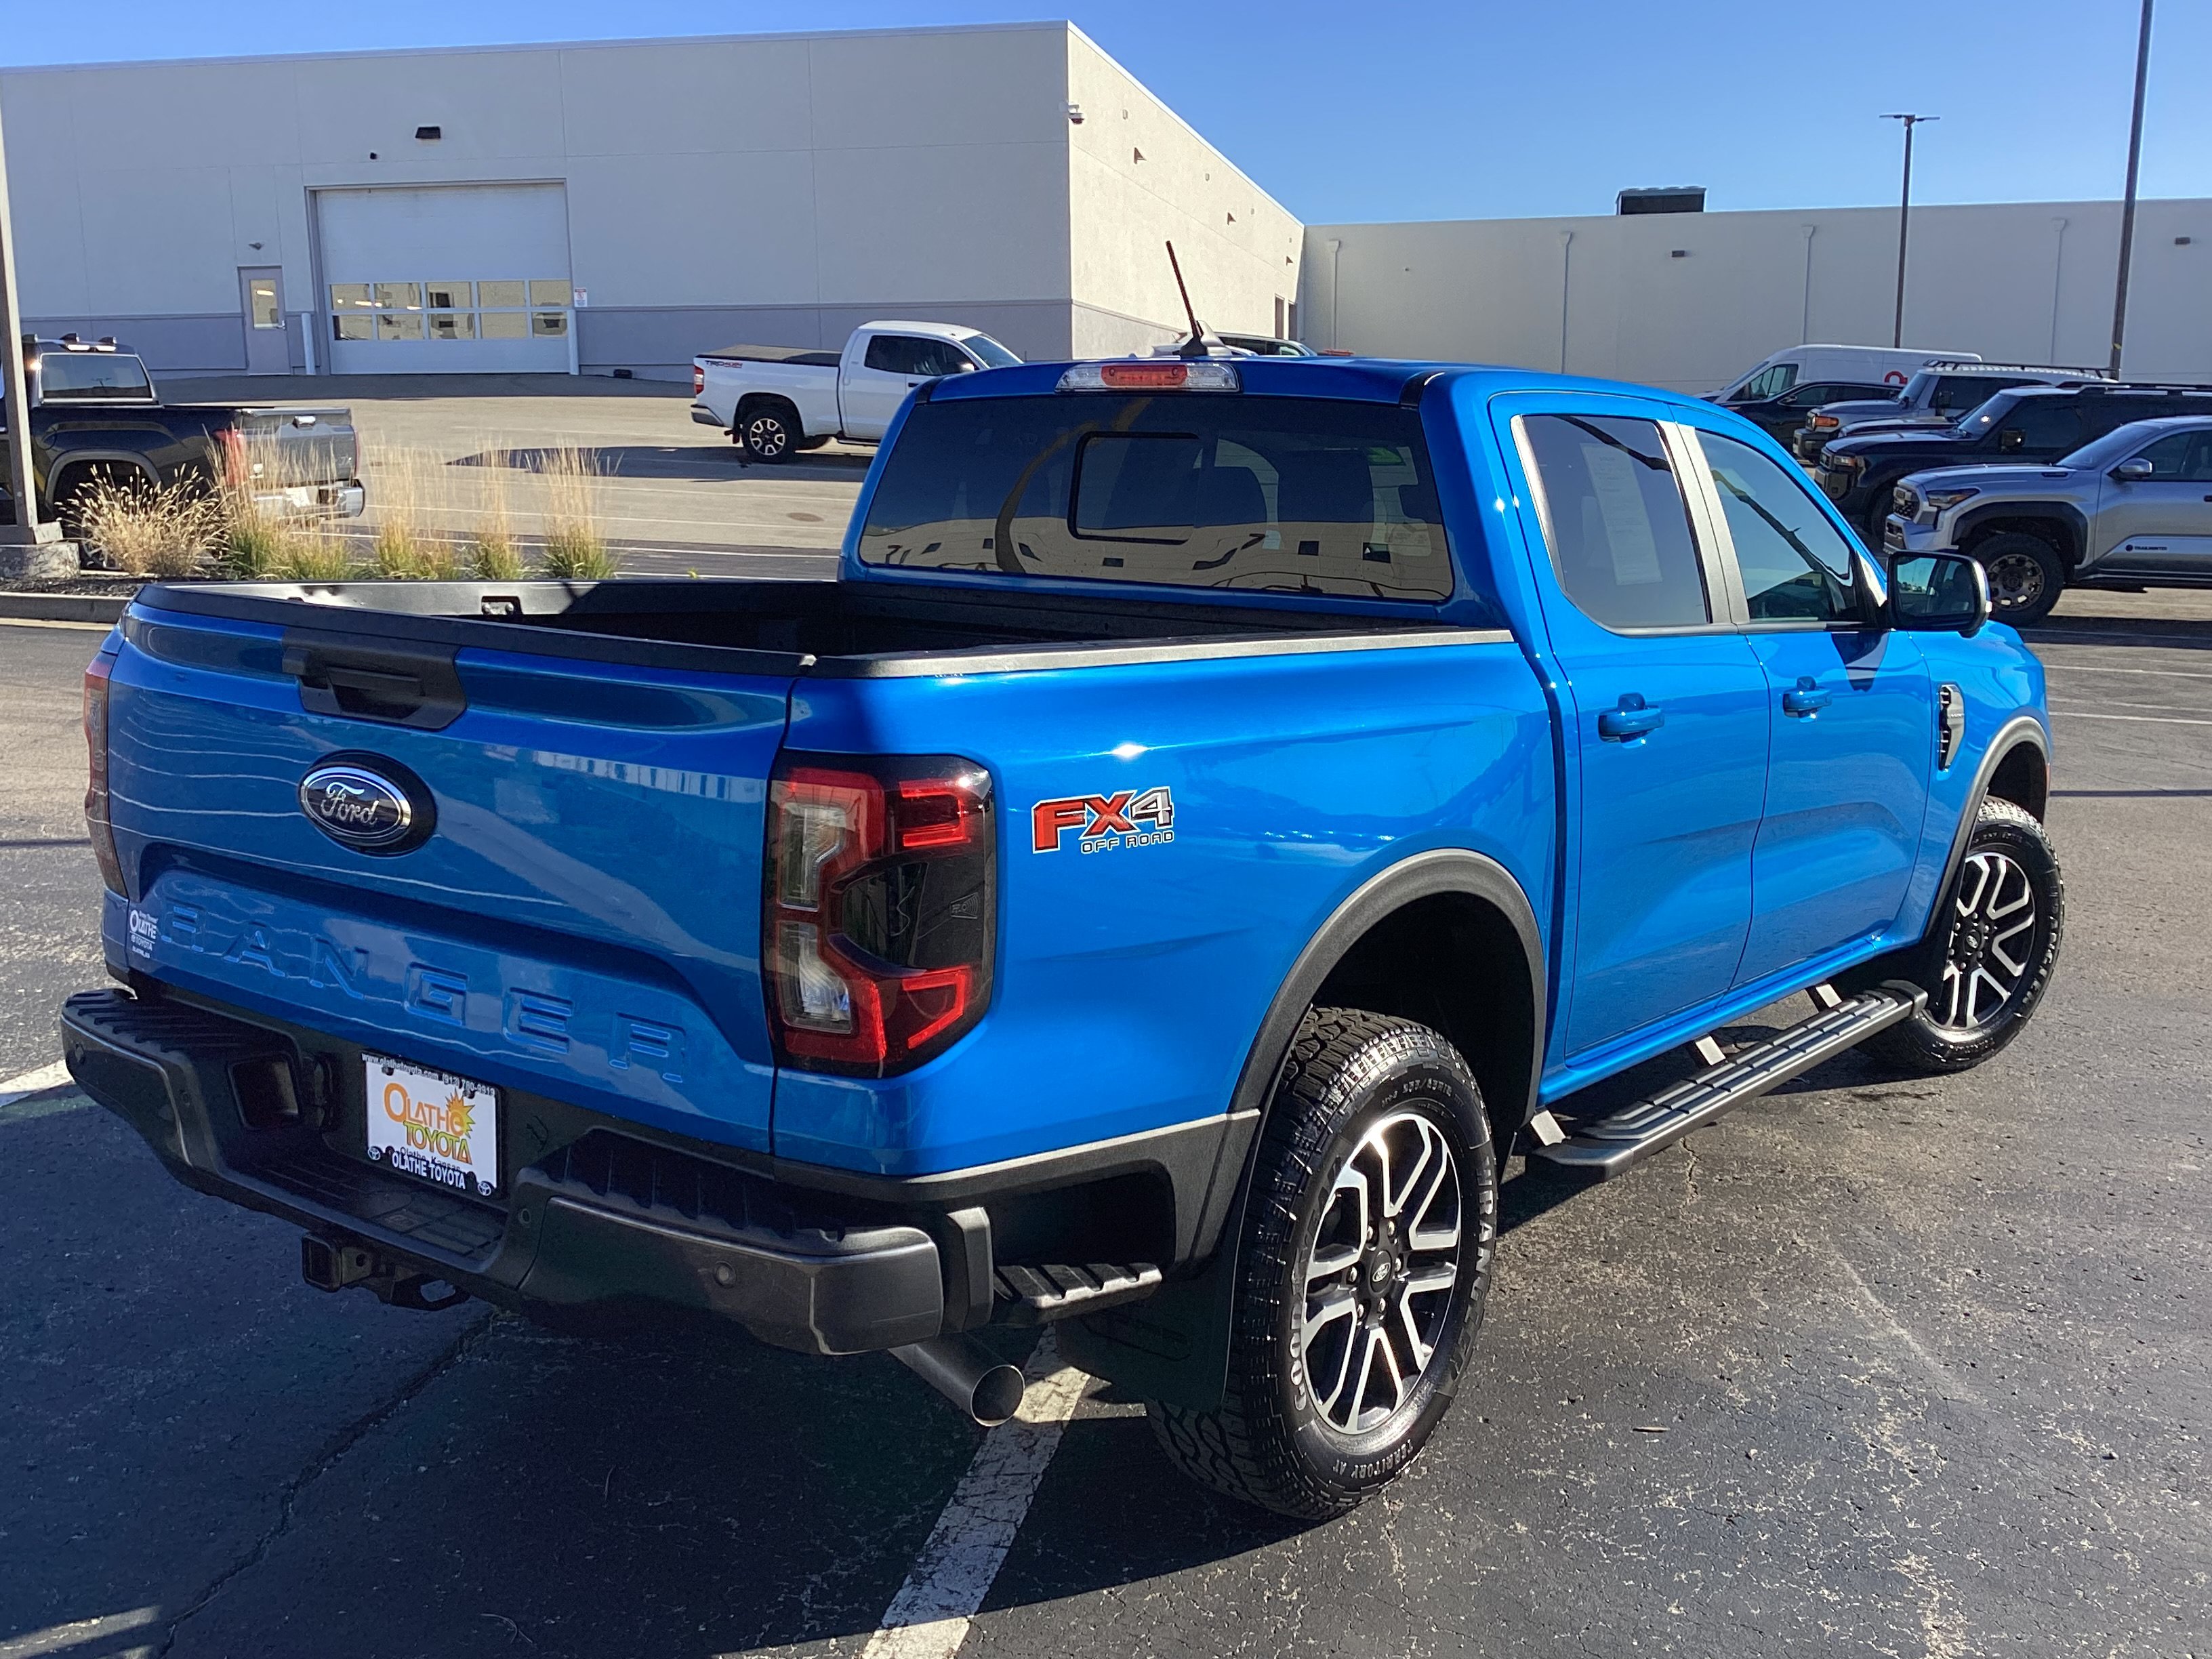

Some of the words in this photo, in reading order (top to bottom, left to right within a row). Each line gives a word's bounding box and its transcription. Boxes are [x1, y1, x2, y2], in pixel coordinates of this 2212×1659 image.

[321, 781, 380, 825] Ford
[1031, 785, 1174, 854] FX4
[1081, 838, 1120, 855] OFF
[1125, 830, 1174, 849] ROAD
[159, 898, 687, 1084] RANGER
[362, 1053, 439, 1080] www.olathetoyota.com
[442, 1073, 461, 1086] (913)
[403, 1120, 473, 1166] TOYOTA
[392, 1152, 428, 1176] OLATHE
[428, 1162, 466, 1189] TOYOTA
